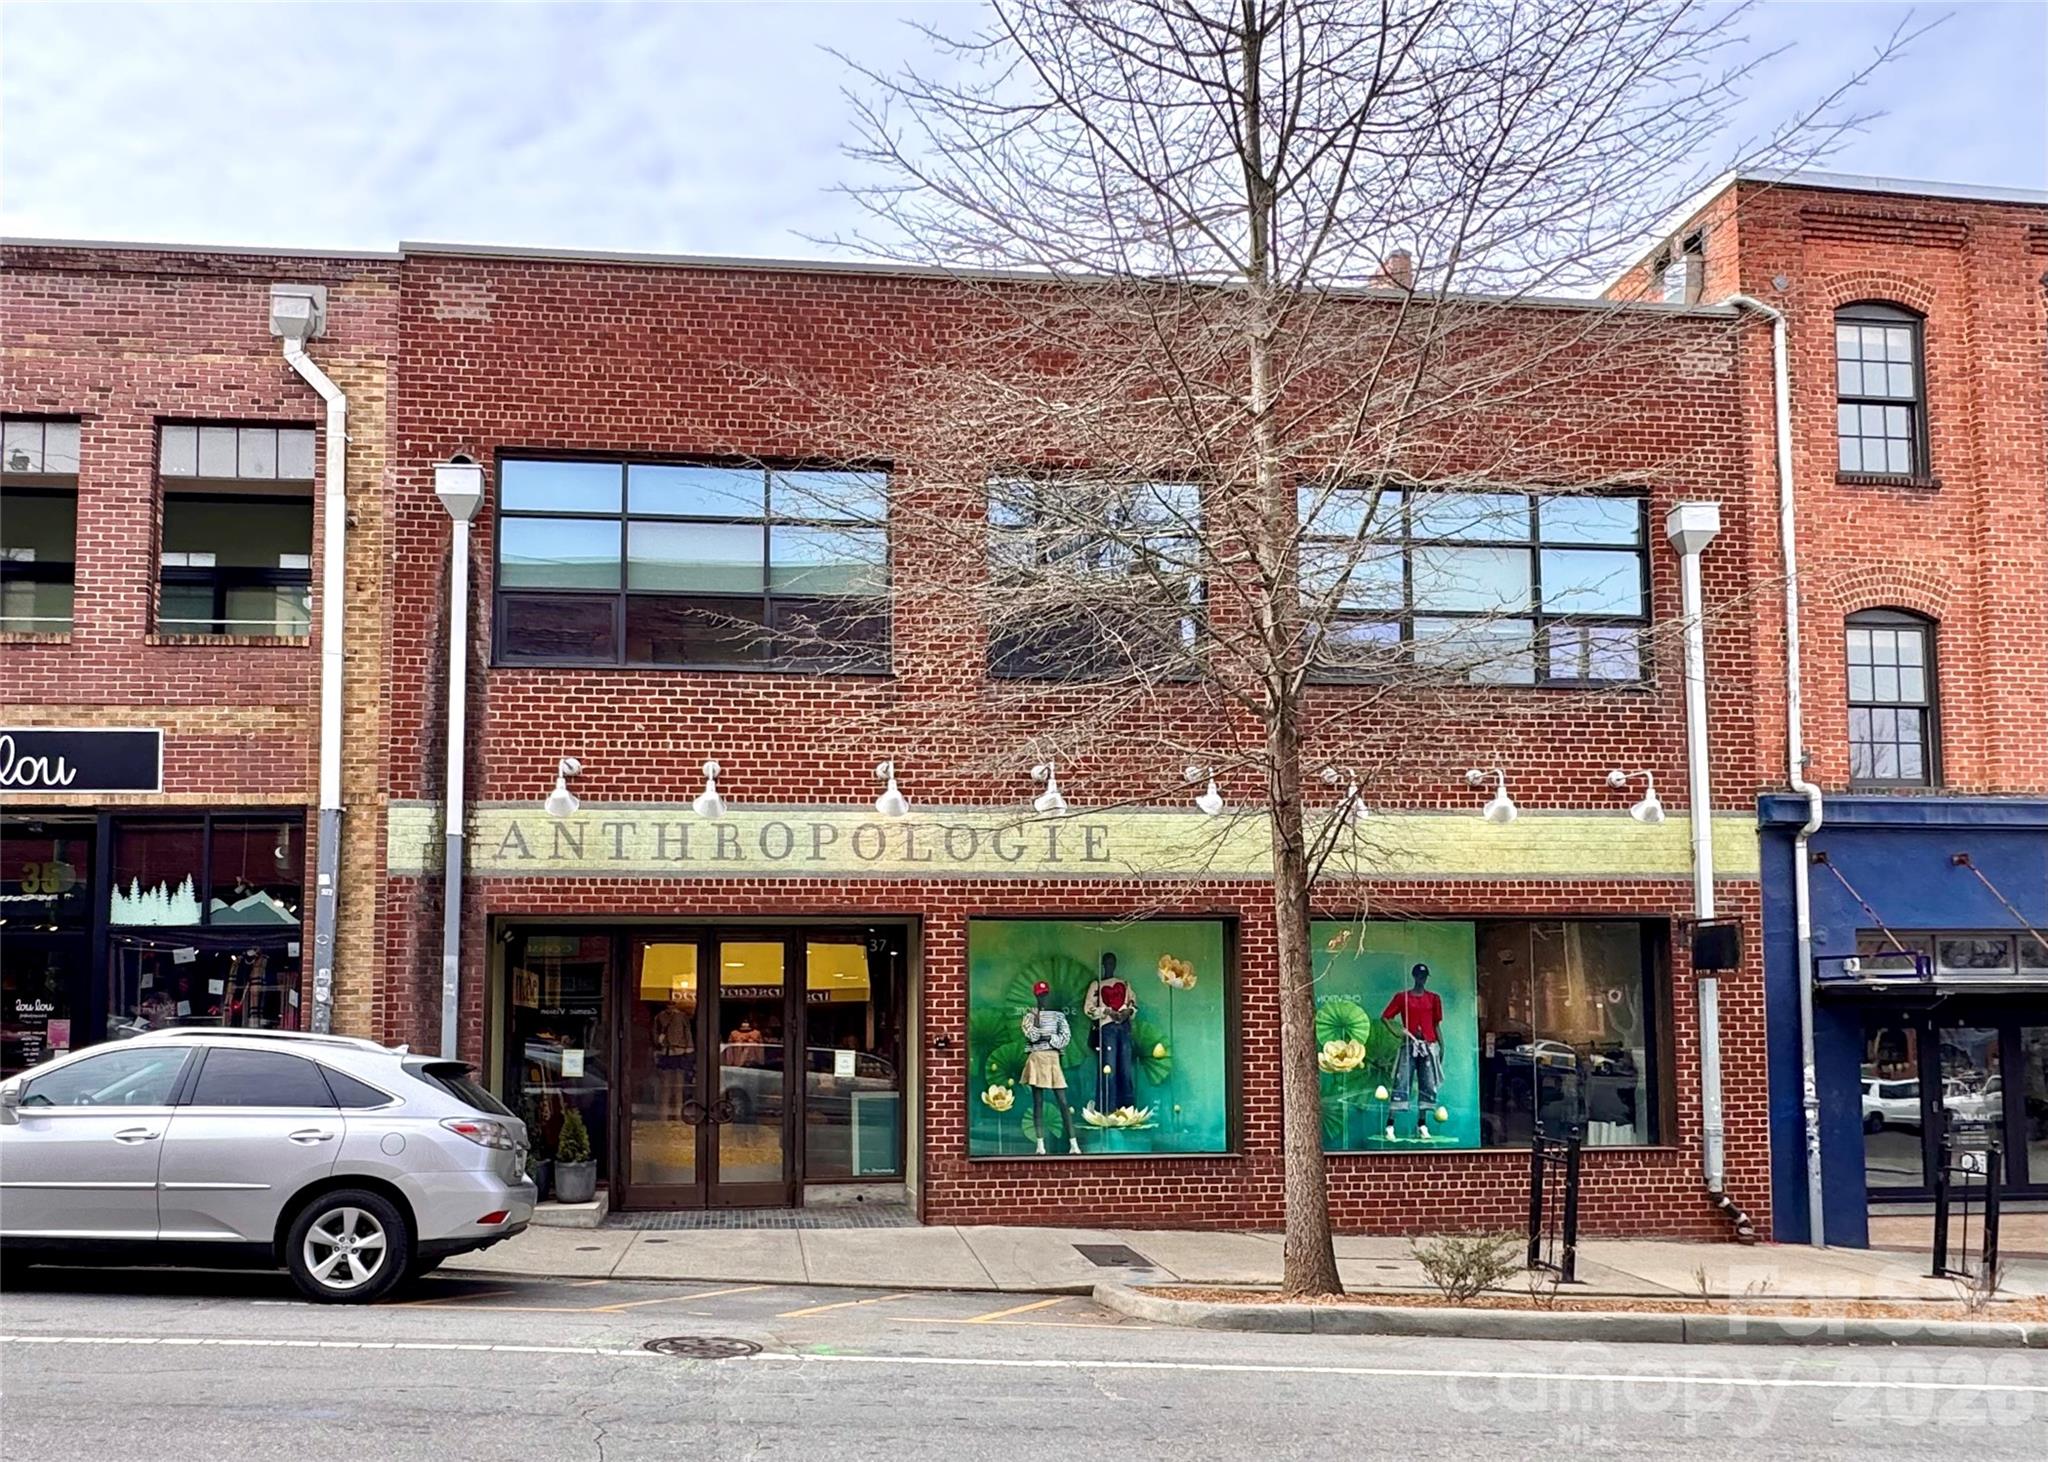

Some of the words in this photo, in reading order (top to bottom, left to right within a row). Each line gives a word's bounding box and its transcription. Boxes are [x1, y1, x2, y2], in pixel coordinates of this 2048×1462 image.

[0, 735, 77, 785] lou
[492, 820, 1111, 862] ANTHROPOLOGIE
[22, 863, 60, 893] 35
[869, 938, 887, 952] 37
[16, 998, 34, 1012] lou
[35, 998, 54, 1012] lou
